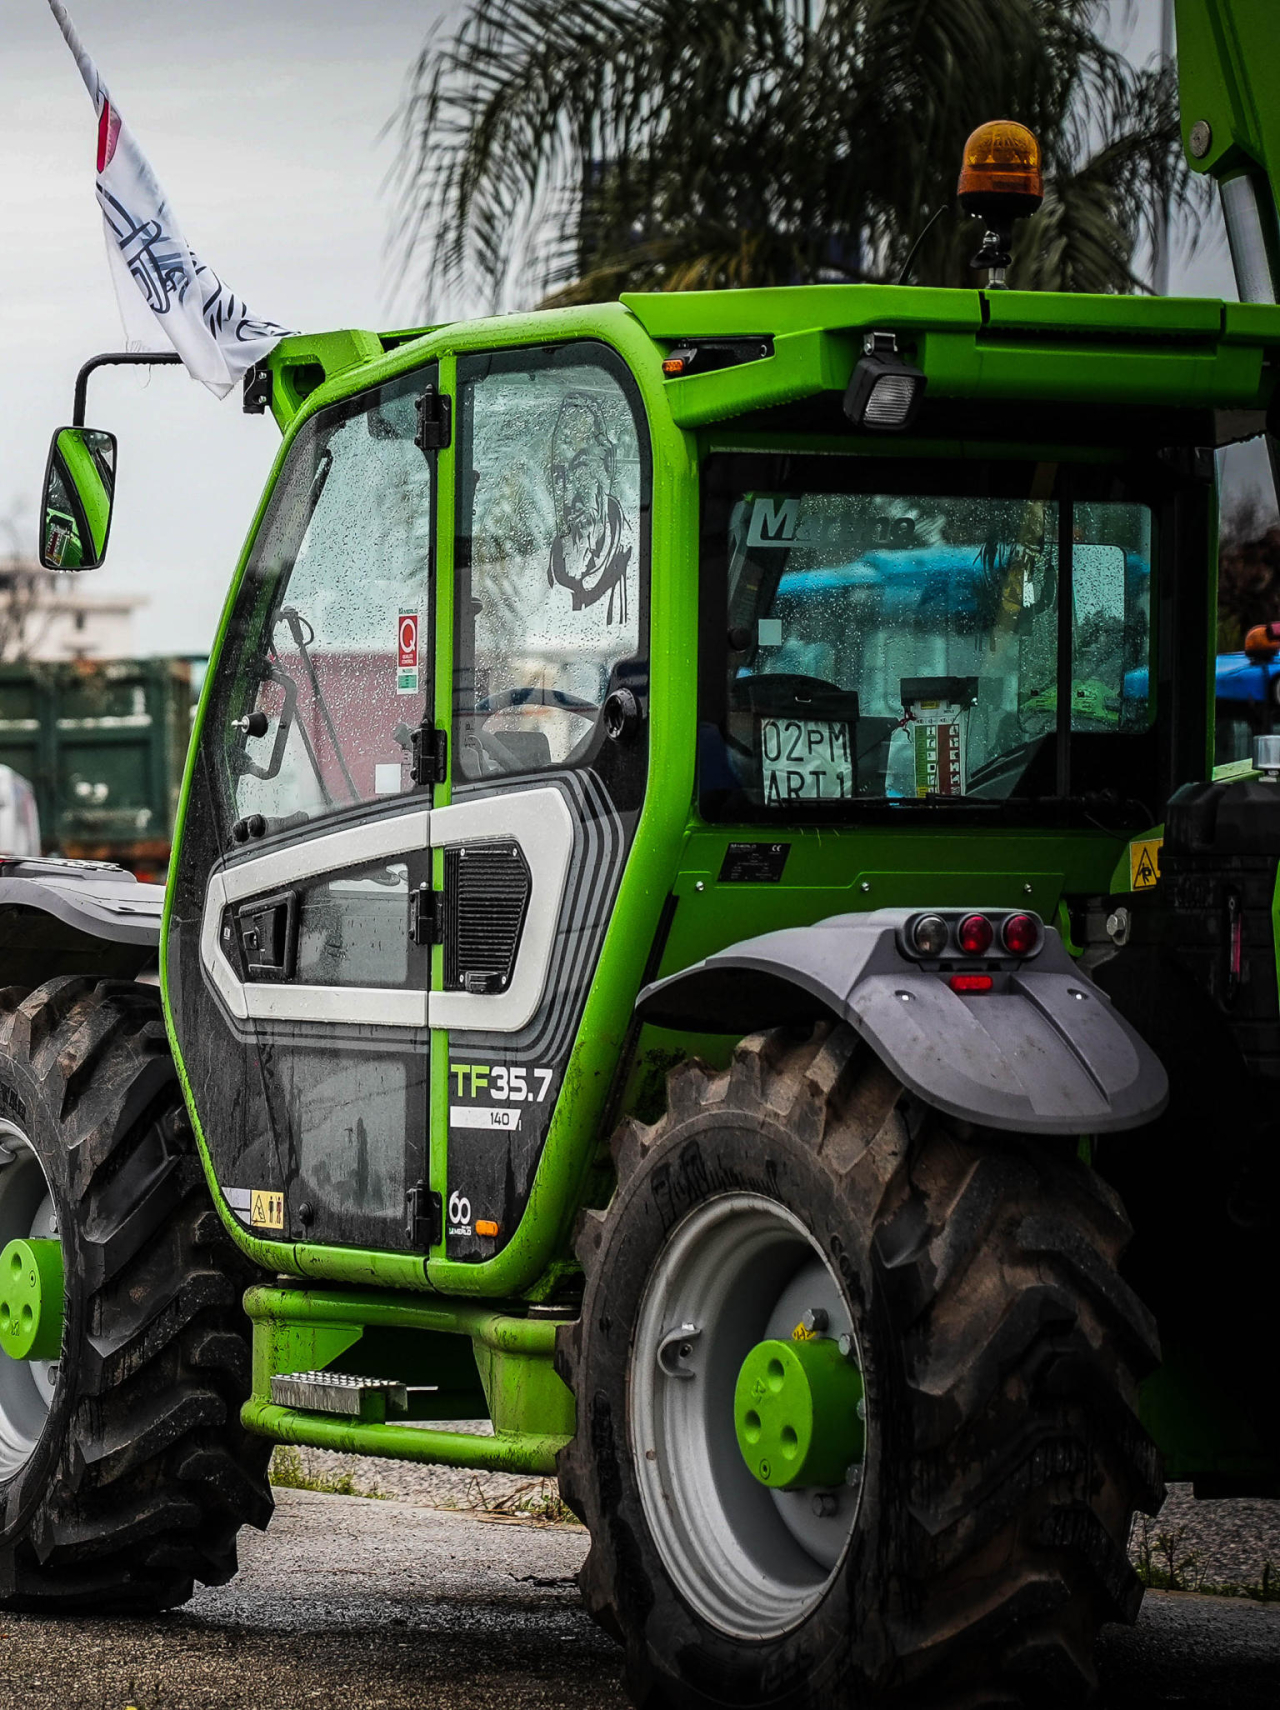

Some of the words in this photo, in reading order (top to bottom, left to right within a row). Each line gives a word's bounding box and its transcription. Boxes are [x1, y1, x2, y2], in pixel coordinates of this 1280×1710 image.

[450, 1064, 553, 1102] TF35.7
[490, 1112, 509, 1126] 140
[449, 1190, 471, 1224] 60
